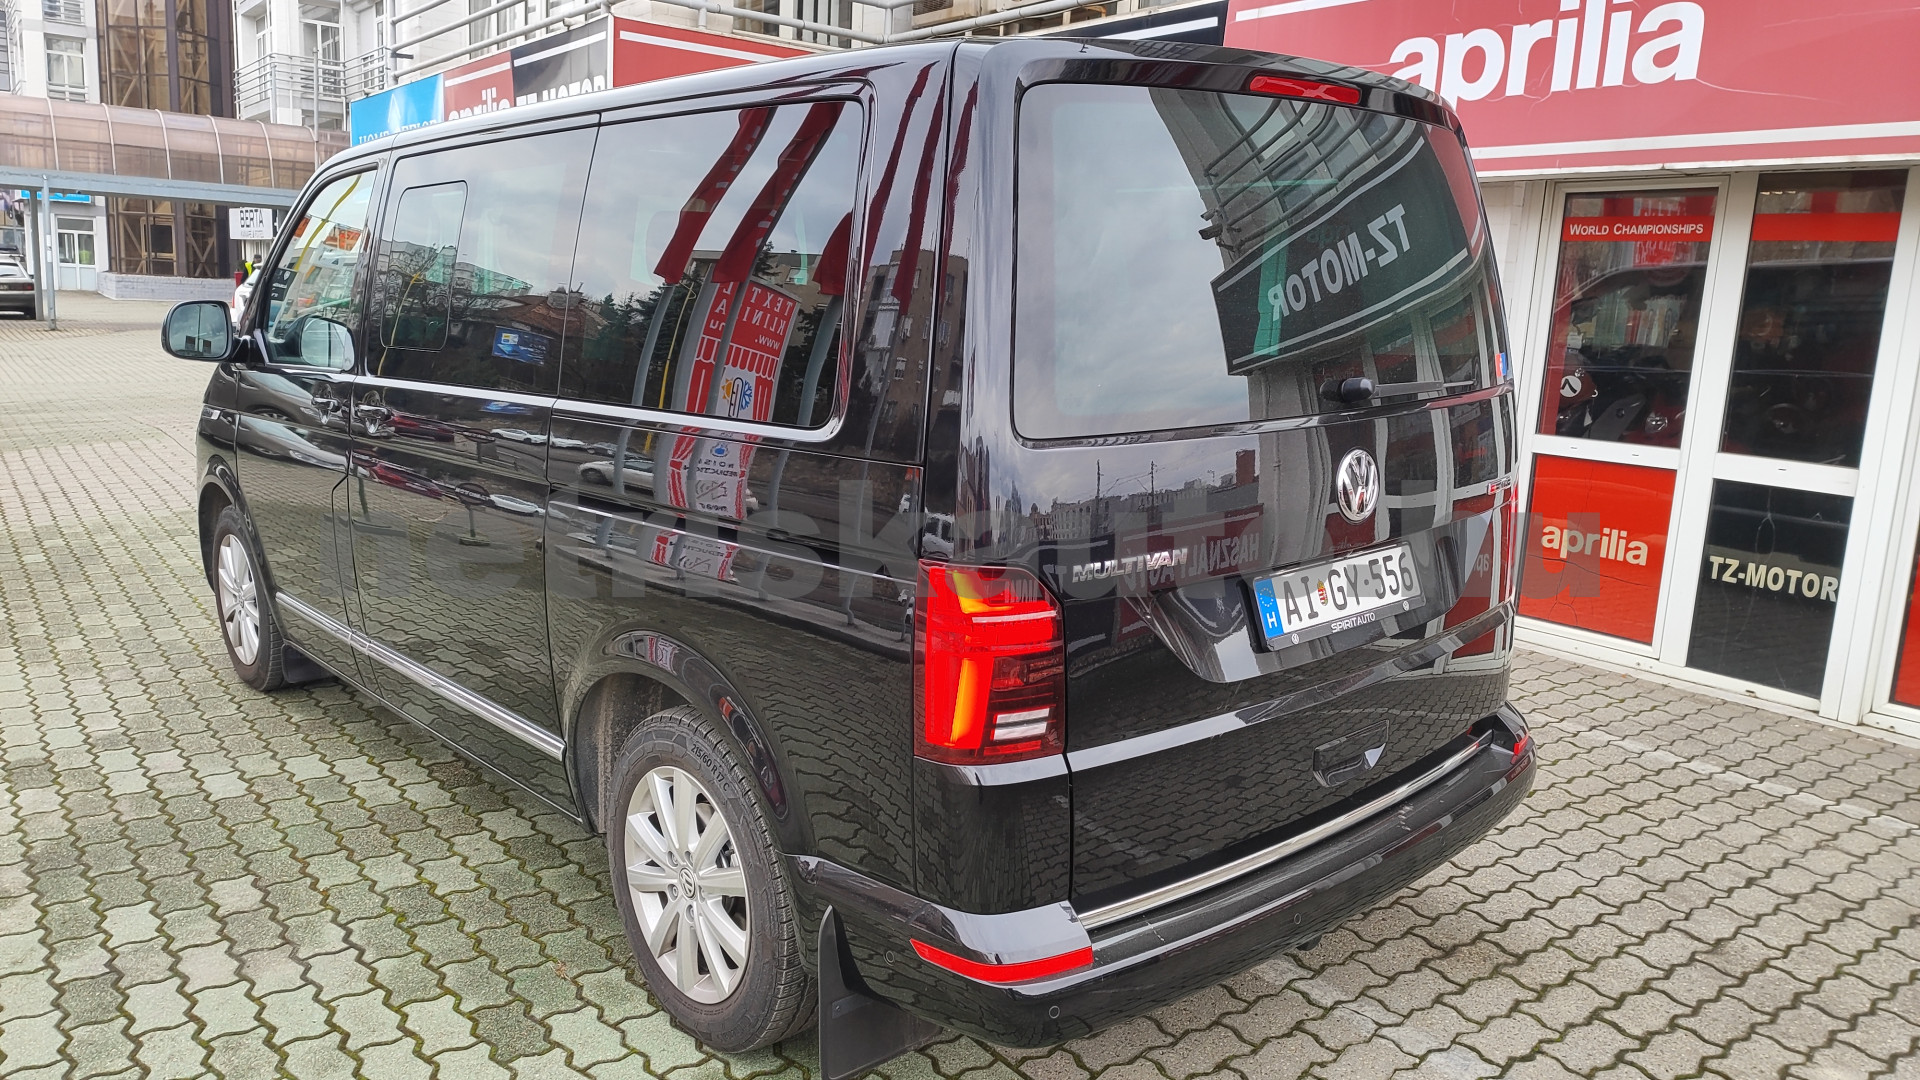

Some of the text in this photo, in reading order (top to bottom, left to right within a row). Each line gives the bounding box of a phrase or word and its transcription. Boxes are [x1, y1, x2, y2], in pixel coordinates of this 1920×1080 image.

[1389, 0, 1704, 112] aprilia
[240, 208, 264, 228] BERTA
[1072, 548, 1188, 583] MULTIVAN
[1541, 525, 1649, 566] aprilia
[1709, 554, 1838, 602] TZ-MOTOR
